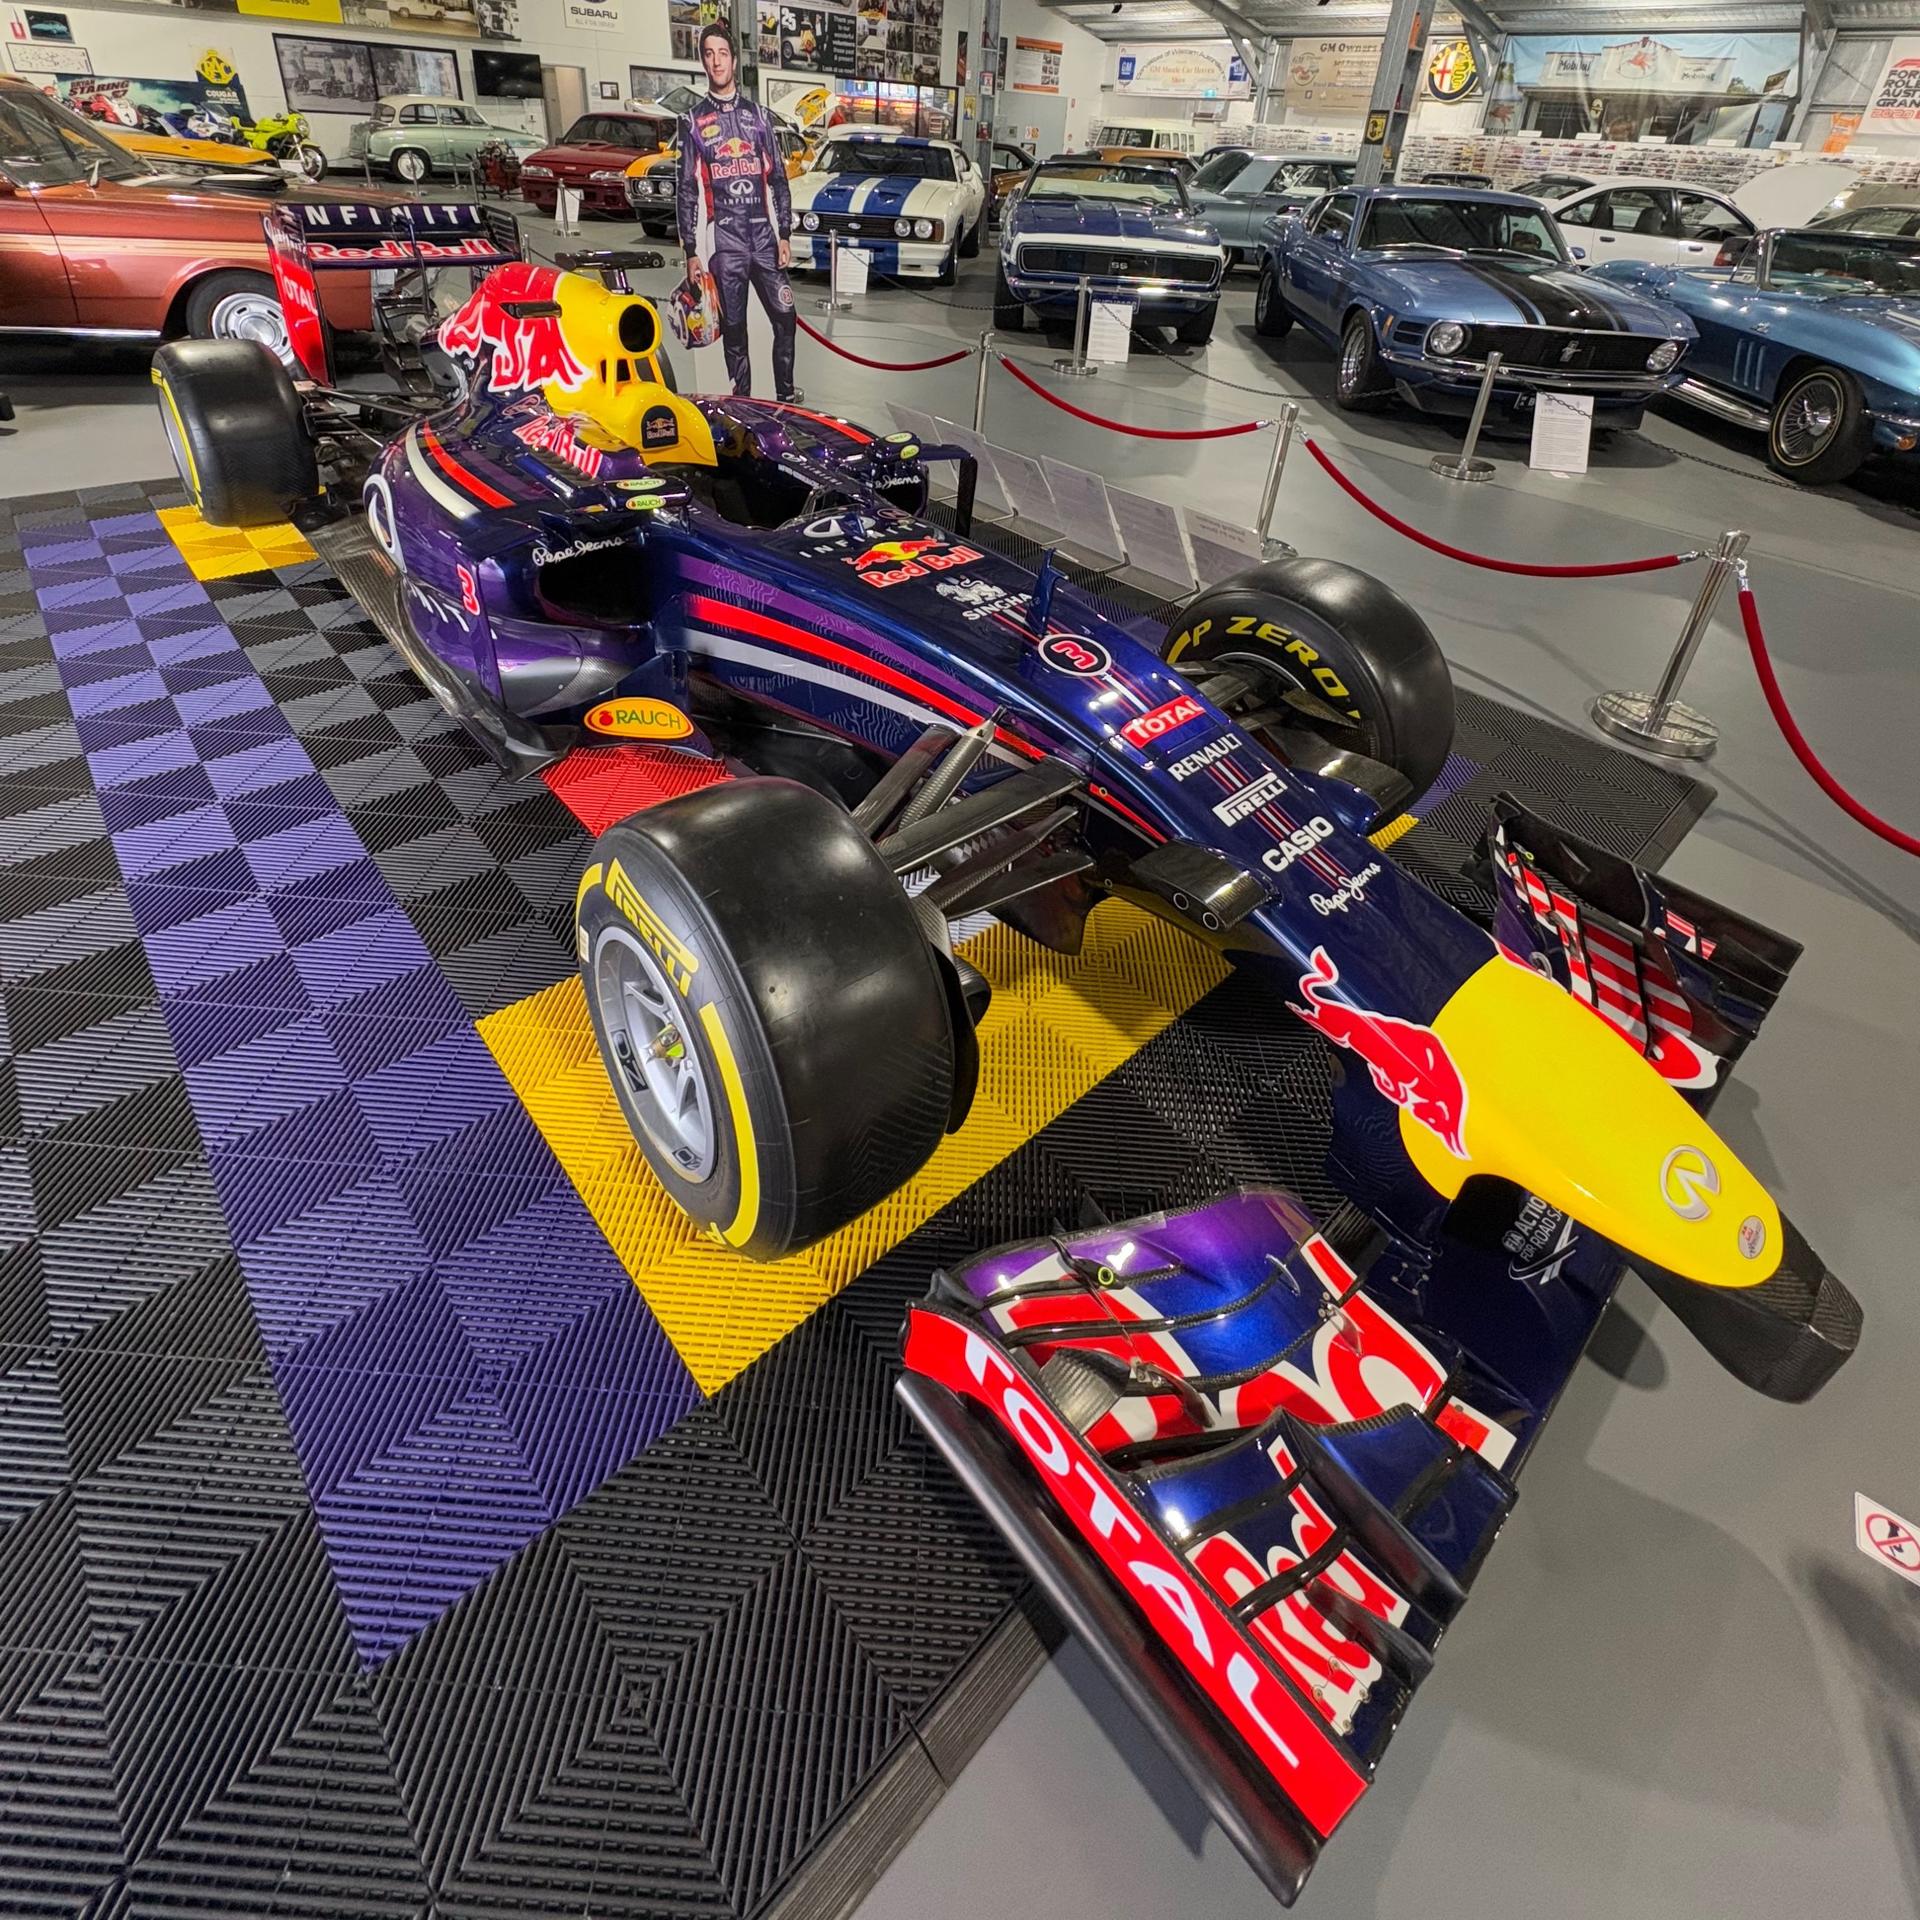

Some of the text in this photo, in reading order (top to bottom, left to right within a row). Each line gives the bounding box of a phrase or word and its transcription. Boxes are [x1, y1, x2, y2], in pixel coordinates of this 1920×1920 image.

[570, 6, 618, 20] SUBARU
[781, 7, 797, 31] 25
[1320, 43, 1336, 53] GM
[69, 80, 129, 97] STARING
[1887, 70, 1920, 80] FOR
[1879, 89, 1920, 98] AUST
[711, 162, 739, 180] Red
[283, 204, 482, 226] NFINITI
[307, 238, 501, 260] Red Bull
[1111, 261, 1129, 270] SS
[636, 499, 662, 507] RAUCH
[532, 536, 626, 567] Pepe Jeans
[858, 545, 985, 588] Red Bull
[455, 563, 481, 616] 3
[962, 591, 1034, 621] SINGHA
[1050, 640, 1098, 670] 3
[1225, 616, 1350, 697] ZERO
[616, 709, 682, 730] RAUCH
[1125, 698, 1205, 742] TOTAL
[1168, 733, 1243, 782] RENAULT
[1211, 772, 1289, 827] PIRELLI
[1262, 816, 1335, 873] CASIO
[1308, 861, 1382, 917] Pepe Jeans
[604, 857, 700, 998] PIRELLI
[1514, 1195, 1548, 1237] ACTIO
[1519, 1243, 1538, 1262] FOR
[1529, 1216, 1557, 1250] ROAD
[962, 1327, 1301, 1769] TOTAL
[1186, 1433, 1412, 1738] Red
